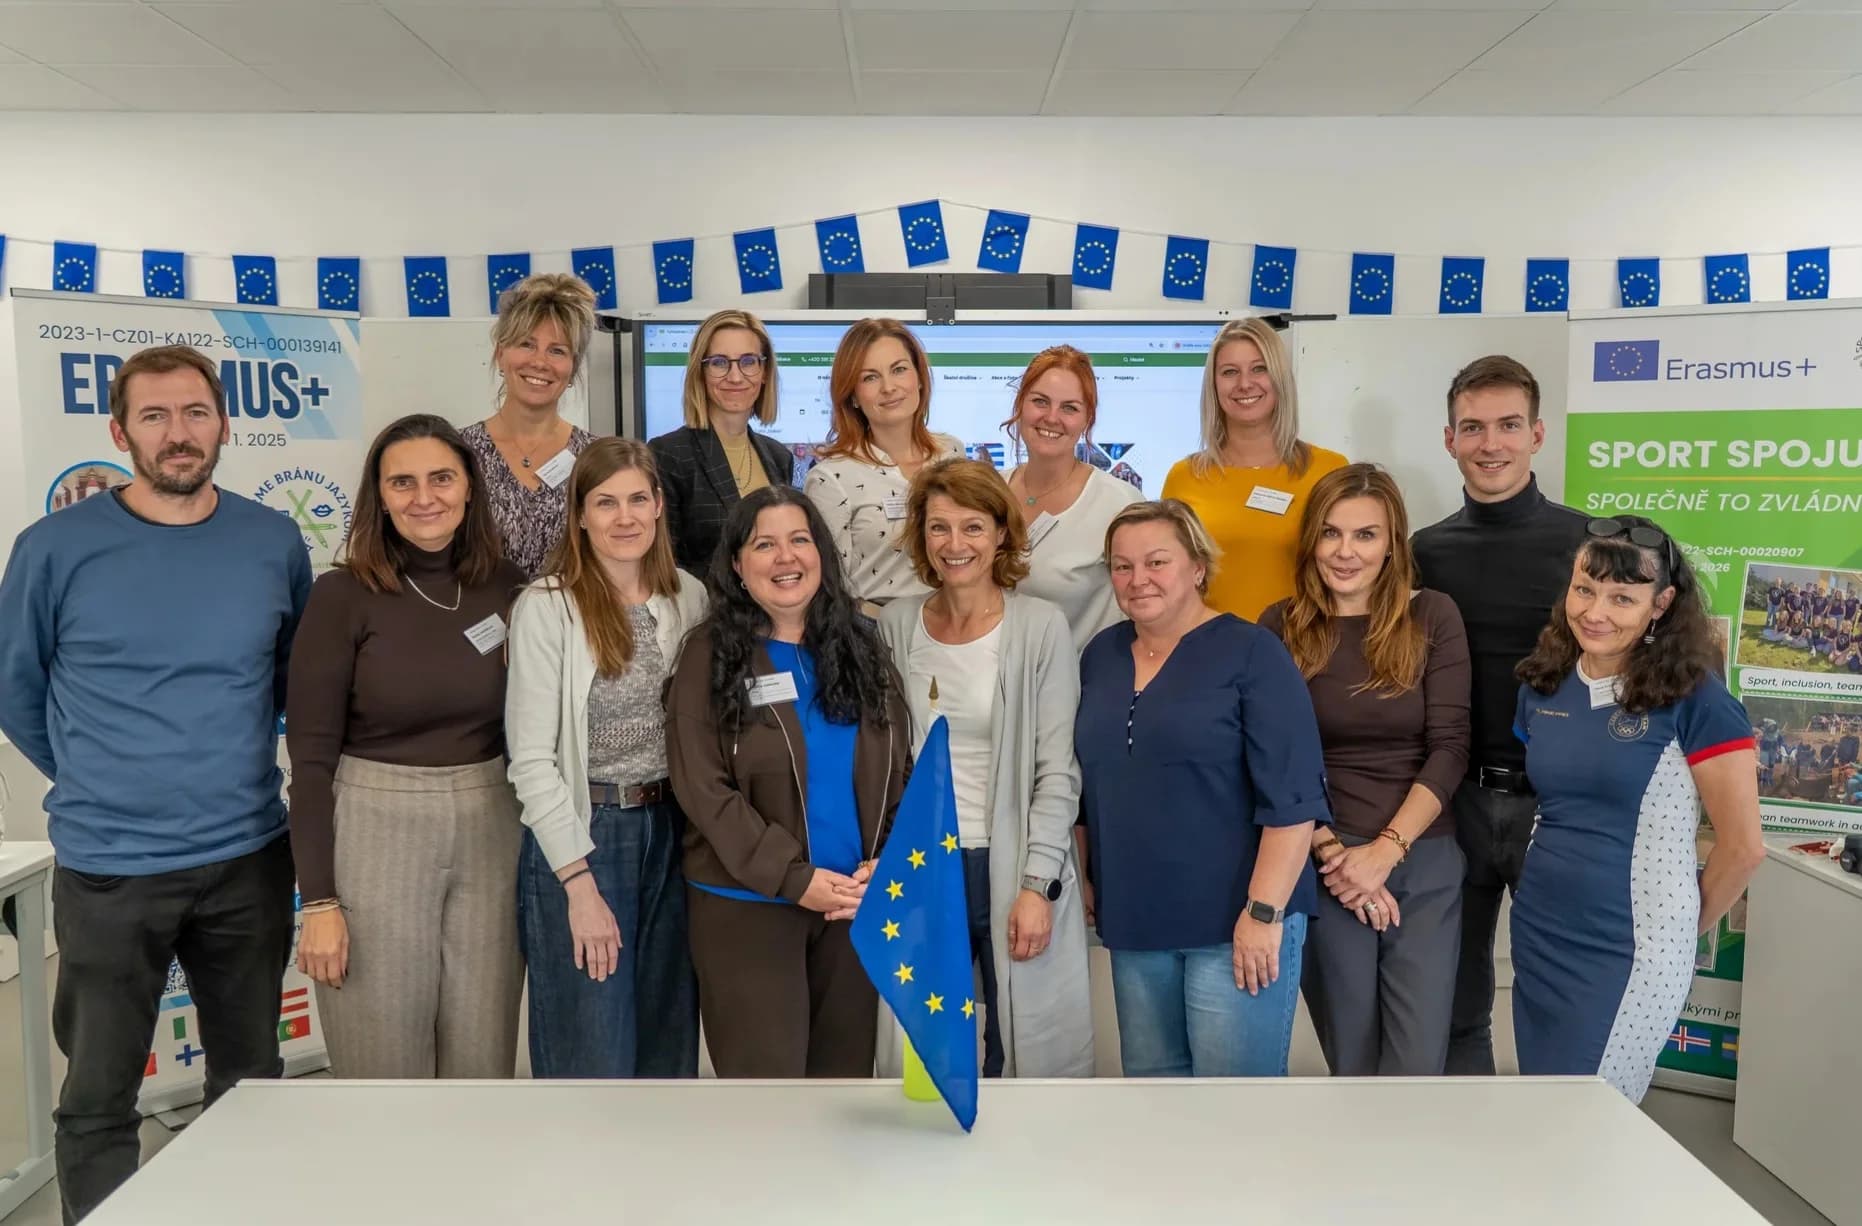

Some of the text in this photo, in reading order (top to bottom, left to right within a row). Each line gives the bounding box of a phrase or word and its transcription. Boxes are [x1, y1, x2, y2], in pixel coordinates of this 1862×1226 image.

[39, 324, 342, 354] 2023-1-CZ01-KA122-SCH-000139141
[1666, 357, 1817, 381] Erasmus+
[247, 433, 287, 447] 2025
[1588, 438, 1862, 469] SPORT SPOJU
[274, 466, 326, 485] BRÁNU
[1586, 489, 1710, 511] SPOLEČNĚ
[1718, 493, 1750, 512] TO
[1747, 676, 1778, 687] Sport,
[1781, 678, 1833, 690] inclusion,
[1779, 815, 1835, 828] teamwork
